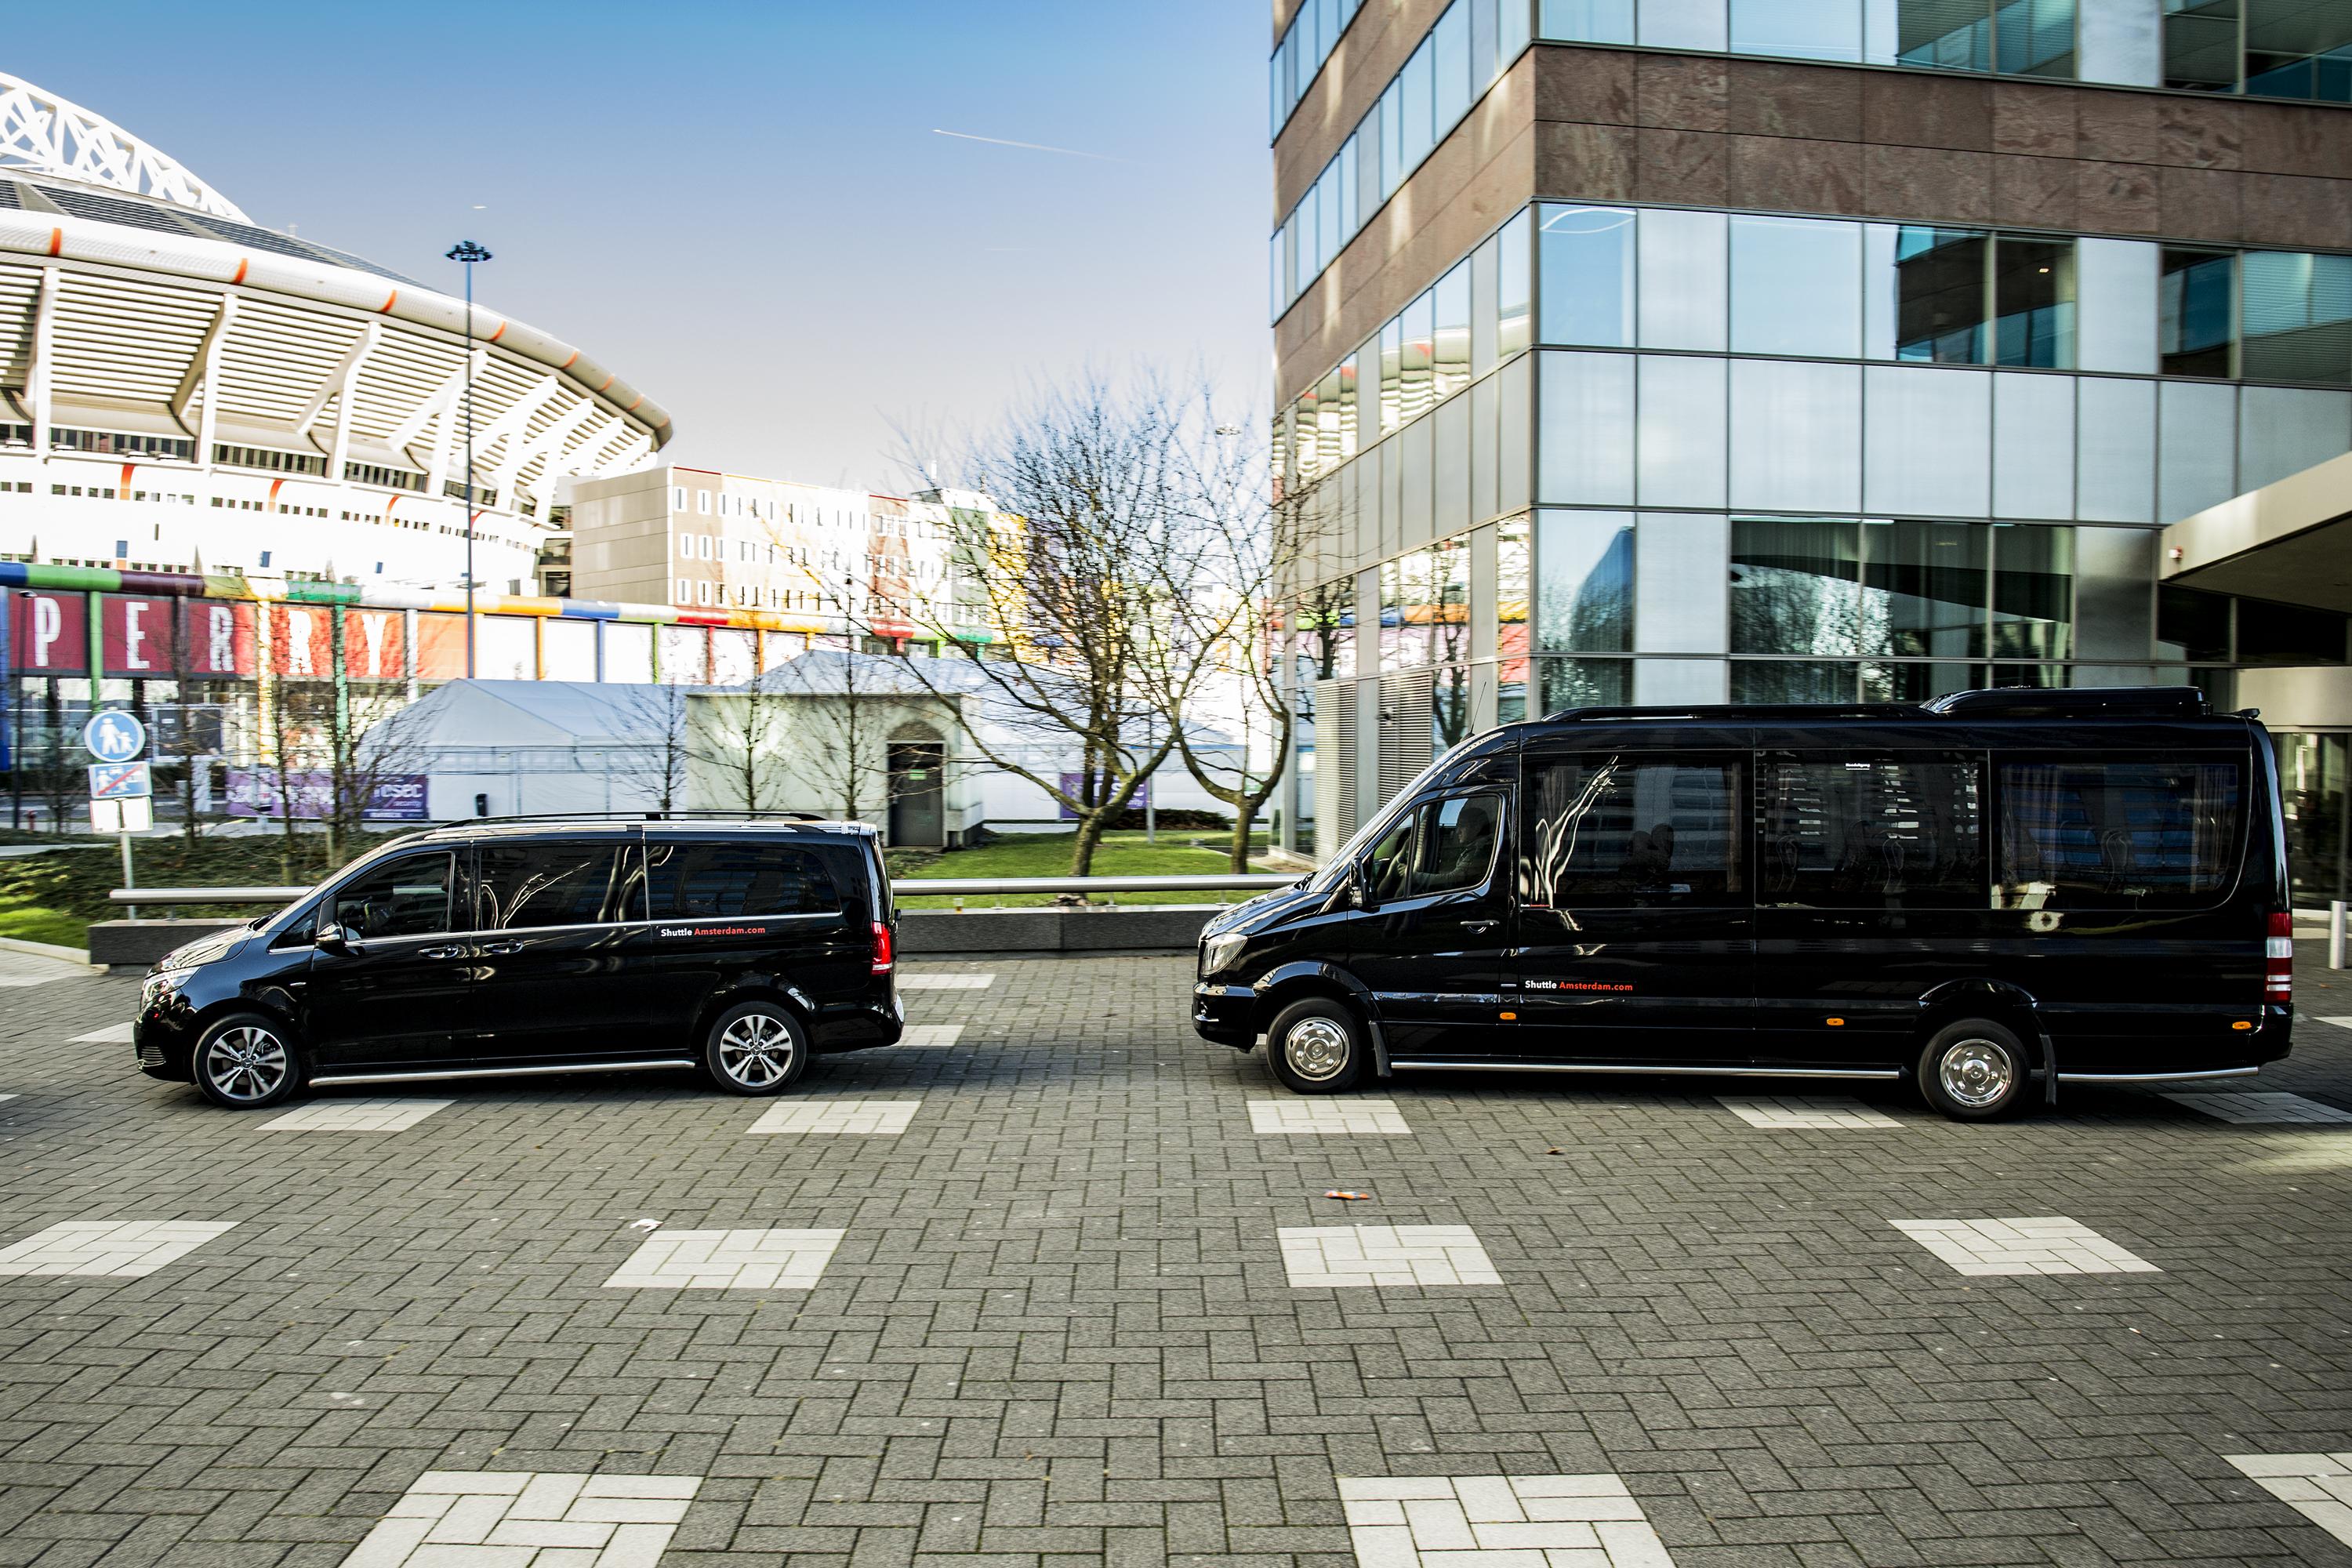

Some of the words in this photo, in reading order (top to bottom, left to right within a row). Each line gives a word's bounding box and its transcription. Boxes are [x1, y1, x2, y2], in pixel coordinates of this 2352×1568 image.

[34, 597, 388, 676] PERRY
[661, 927, 693, 937] Shuttle
[694, 926, 766, 936] Amsterdam.com
[1525, 980, 1557, 989] Shuttle
[1559, 982, 1633, 991] Amsterdam.com
